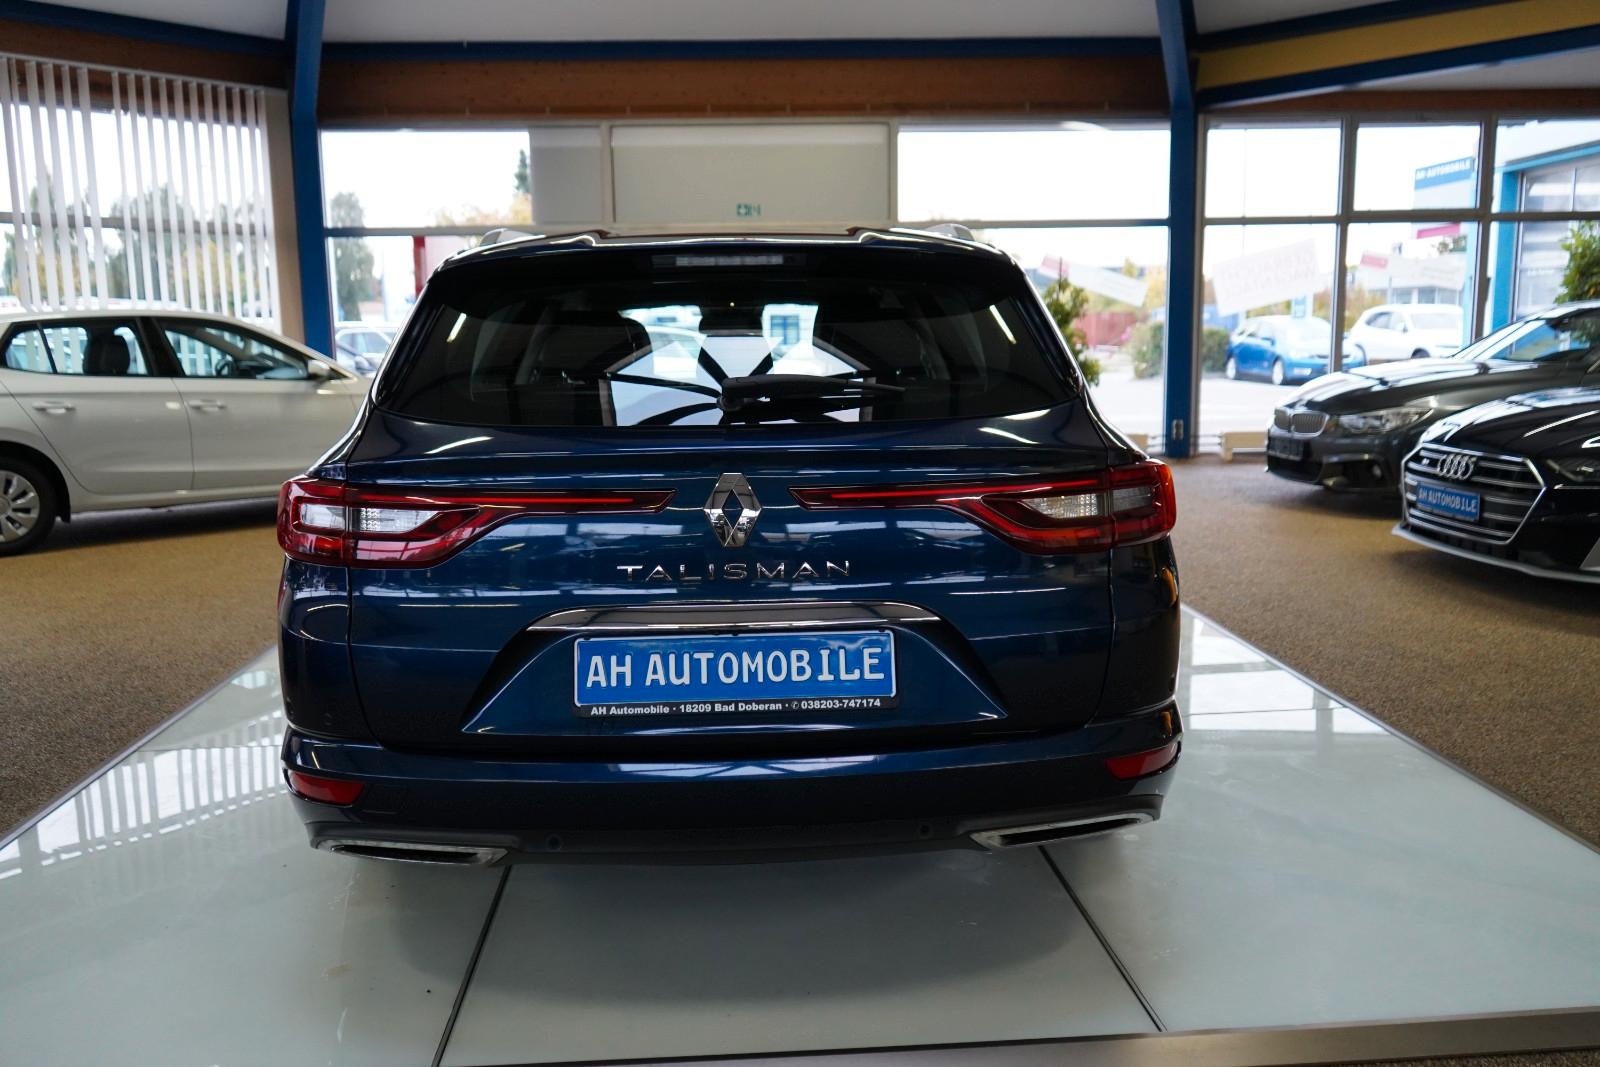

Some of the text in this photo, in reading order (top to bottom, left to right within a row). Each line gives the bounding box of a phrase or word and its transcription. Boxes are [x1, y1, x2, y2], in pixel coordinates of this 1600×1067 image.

[1428, 489, 1477, 513] AUTOMOBILE
[616, 560, 850, 582] TALISMAN
[586, 647, 885, 688] AH AUTOMOBILE
[590, 698, 881, 716] AH Automobile 18209 Bad Doberan 038203-747174
